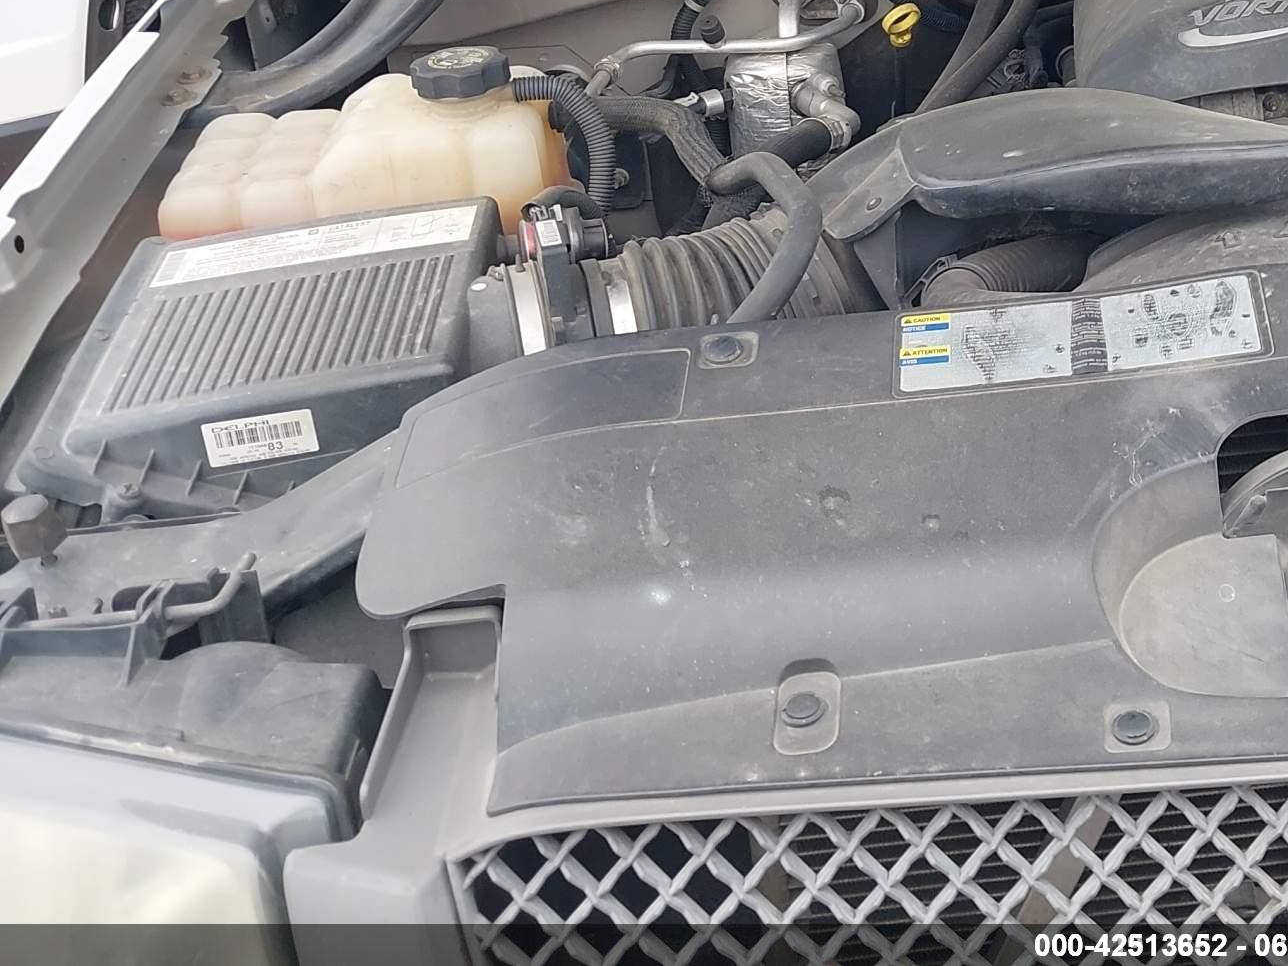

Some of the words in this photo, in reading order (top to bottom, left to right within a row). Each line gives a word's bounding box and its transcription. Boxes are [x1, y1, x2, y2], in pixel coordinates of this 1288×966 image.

[913, 316, 941, 324] CAUTION
[912, 348, 948, 356] ATTENTION
[211, 420, 270, 434] DELPHI
